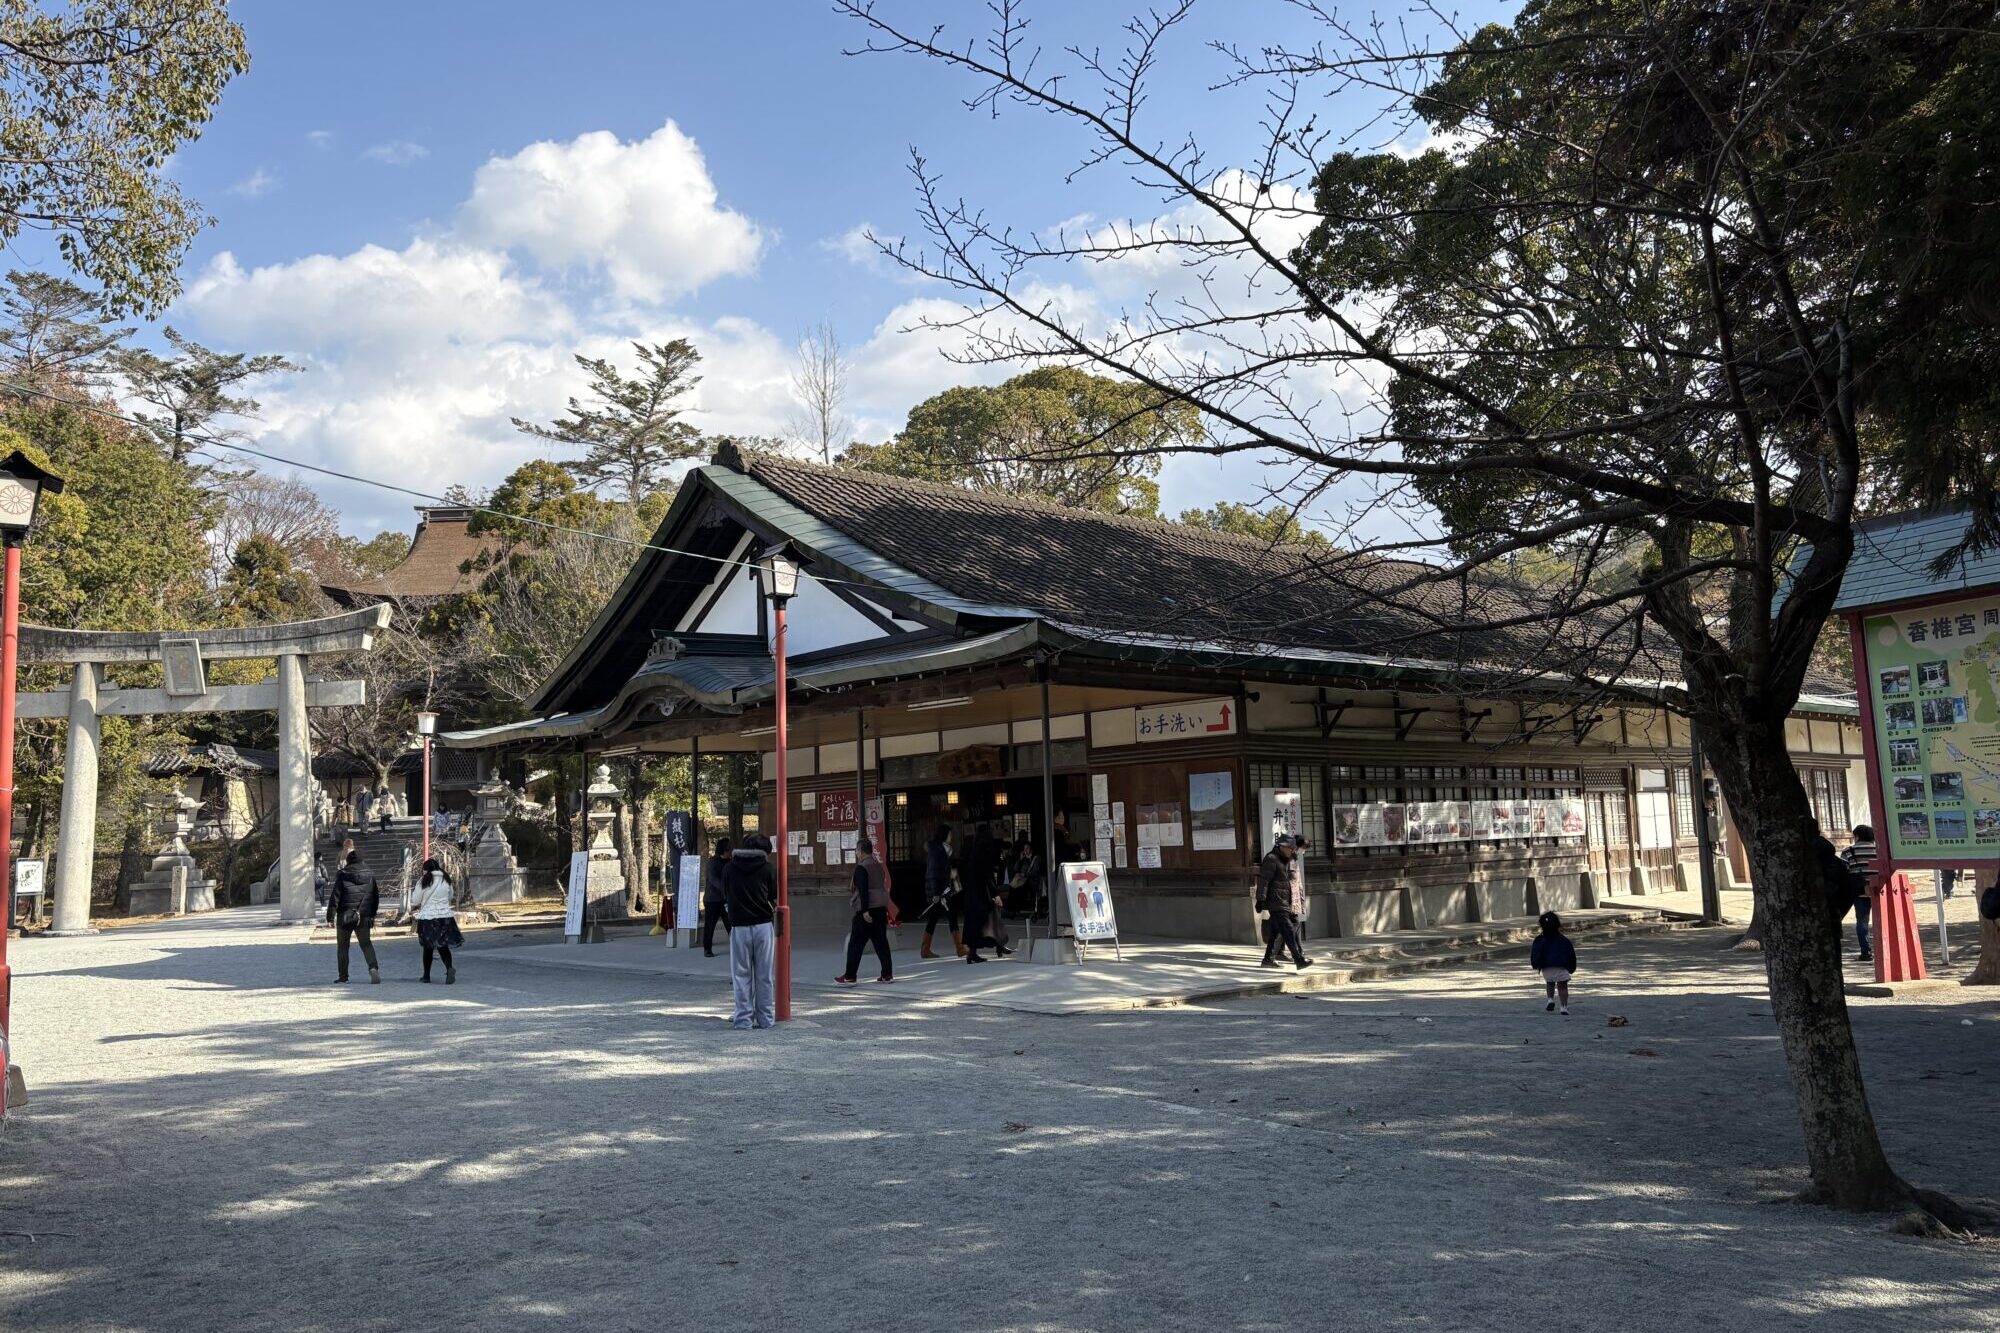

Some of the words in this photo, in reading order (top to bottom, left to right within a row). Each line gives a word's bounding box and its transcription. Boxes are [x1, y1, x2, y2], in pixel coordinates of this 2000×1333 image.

[1139, 712, 1203, 735] お手洗い
[1078, 921, 1114, 934] お手洗い
